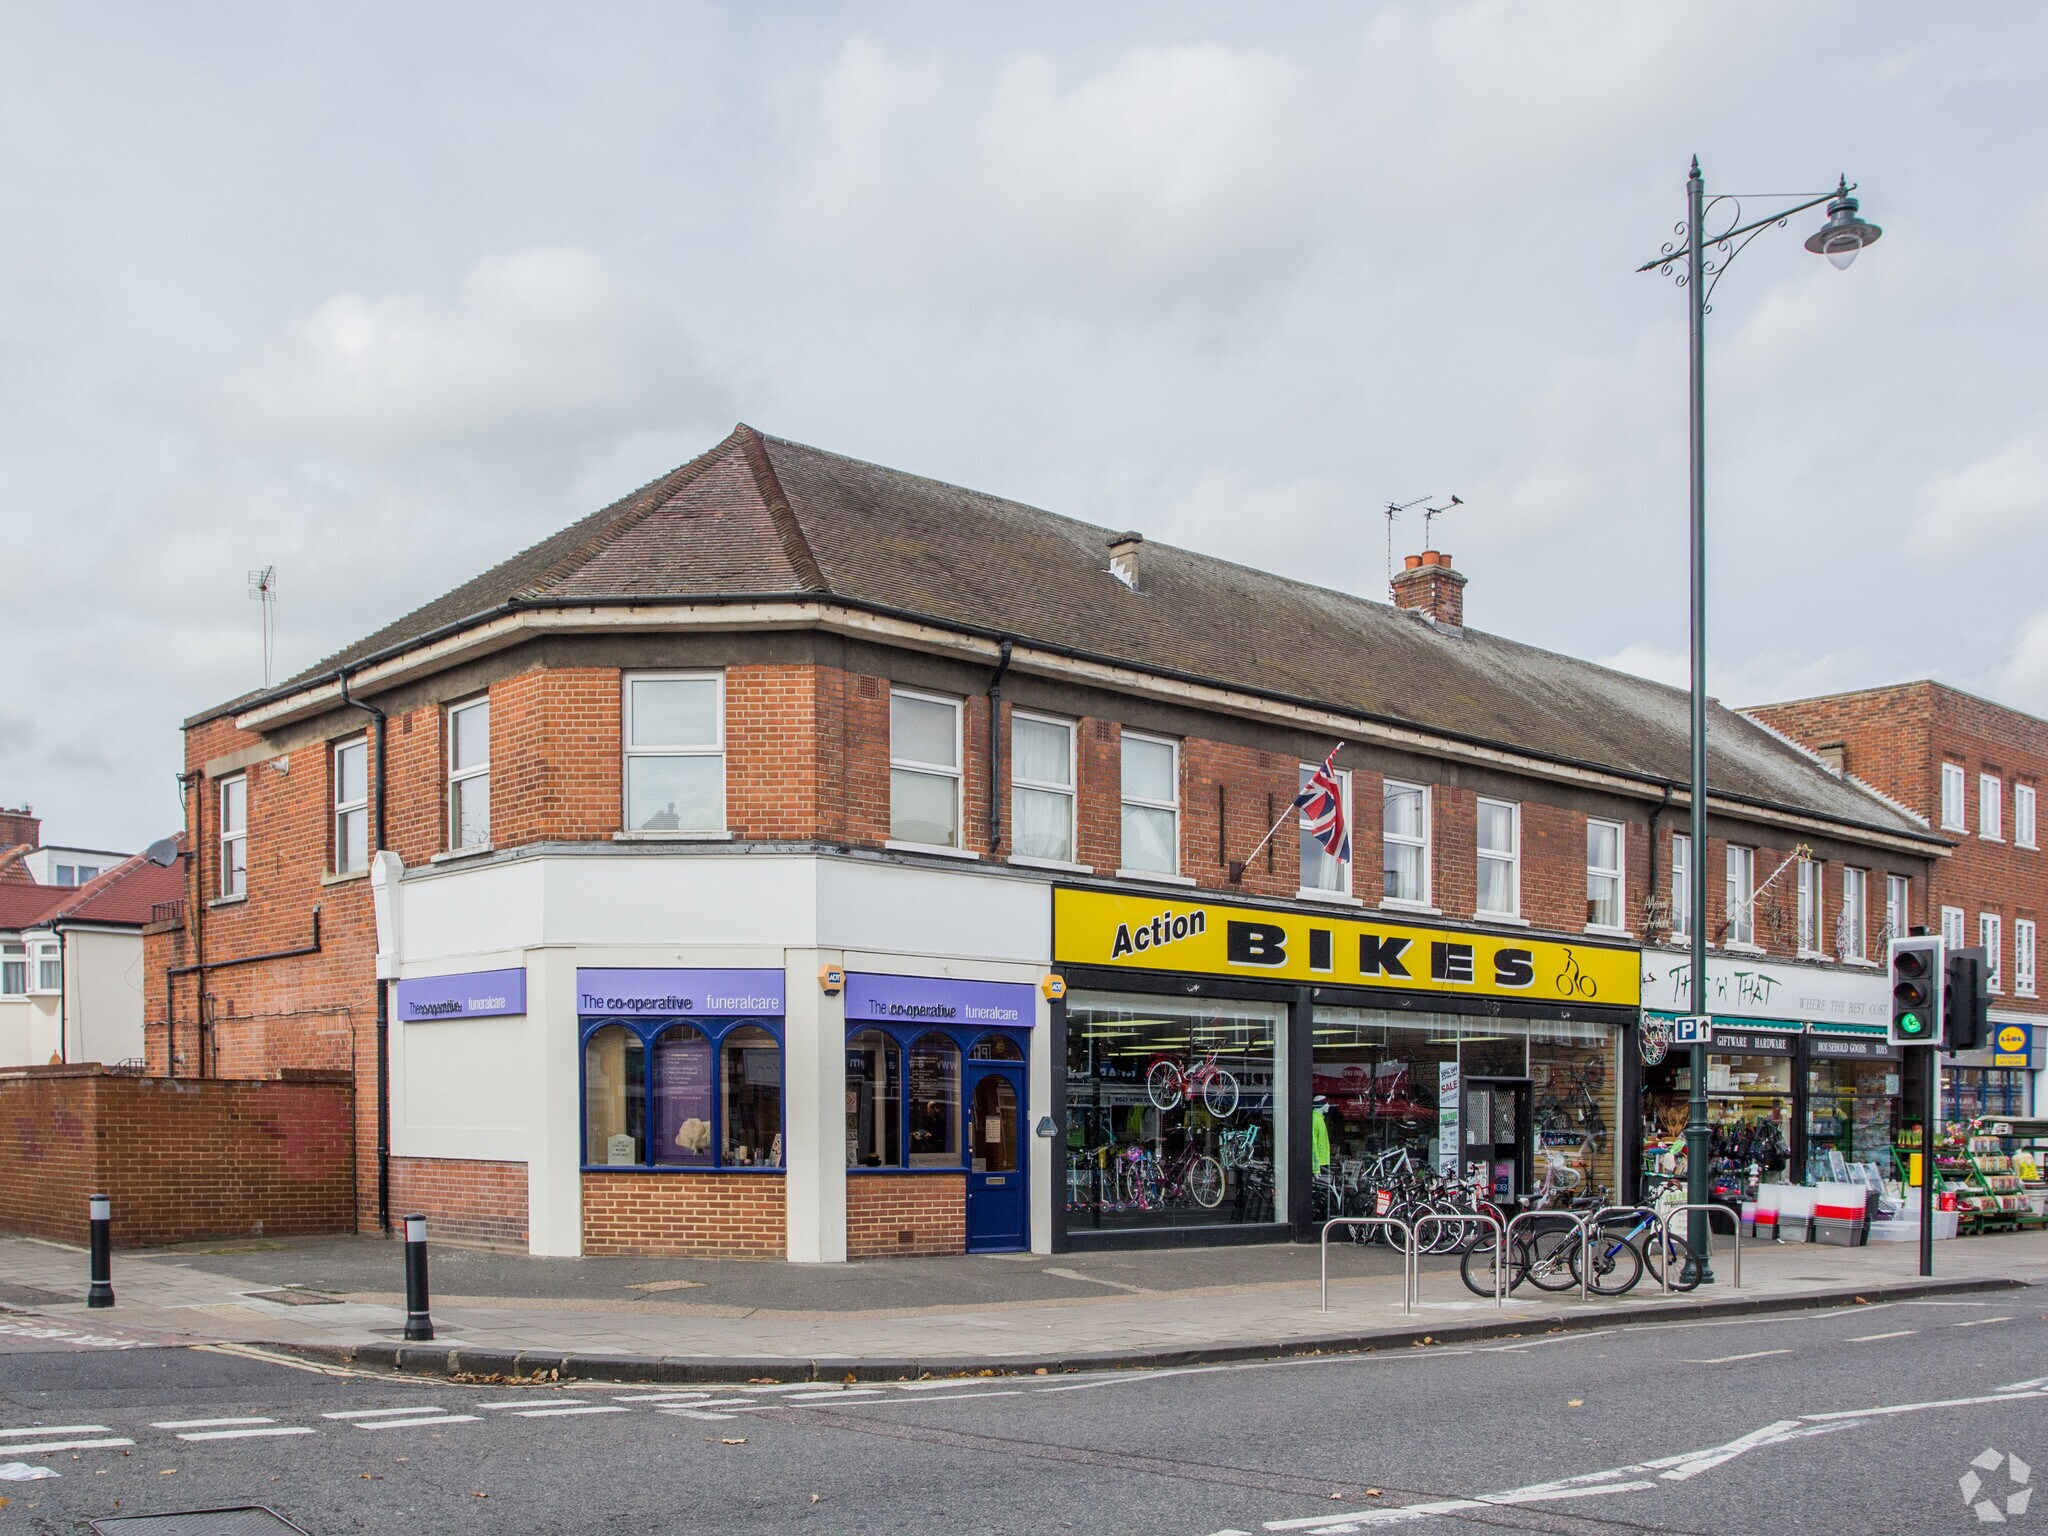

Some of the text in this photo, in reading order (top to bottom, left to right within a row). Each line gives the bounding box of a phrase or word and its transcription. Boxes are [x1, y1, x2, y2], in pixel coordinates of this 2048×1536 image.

[1111, 909, 1534, 988] Action BIKES
[829, 973, 840, 981] ADT
[1669, 963, 1710, 1003] TH
[1734, 971, 1782, 1007] THAT
[409, 1002, 420, 1015] The
[468, 996, 506, 1011] funeralcare
[582, 994, 780, 1012] The co-operative funeralcare
[869, 999, 1018, 1020] The co-operative funeralcare
[1799, 997, 1888, 1016] WHERE THE BEST COST
[1681, 1021, 1695, 1039] P
[1717, 1035, 1787, 1050] GIFTWARE HARDWARE
[1817, 1041, 1849, 1053] HOUSEHOLD
[1849, 1043, 1867, 1054] GOODS
[1441, 1079, 1458, 1094] SALE
